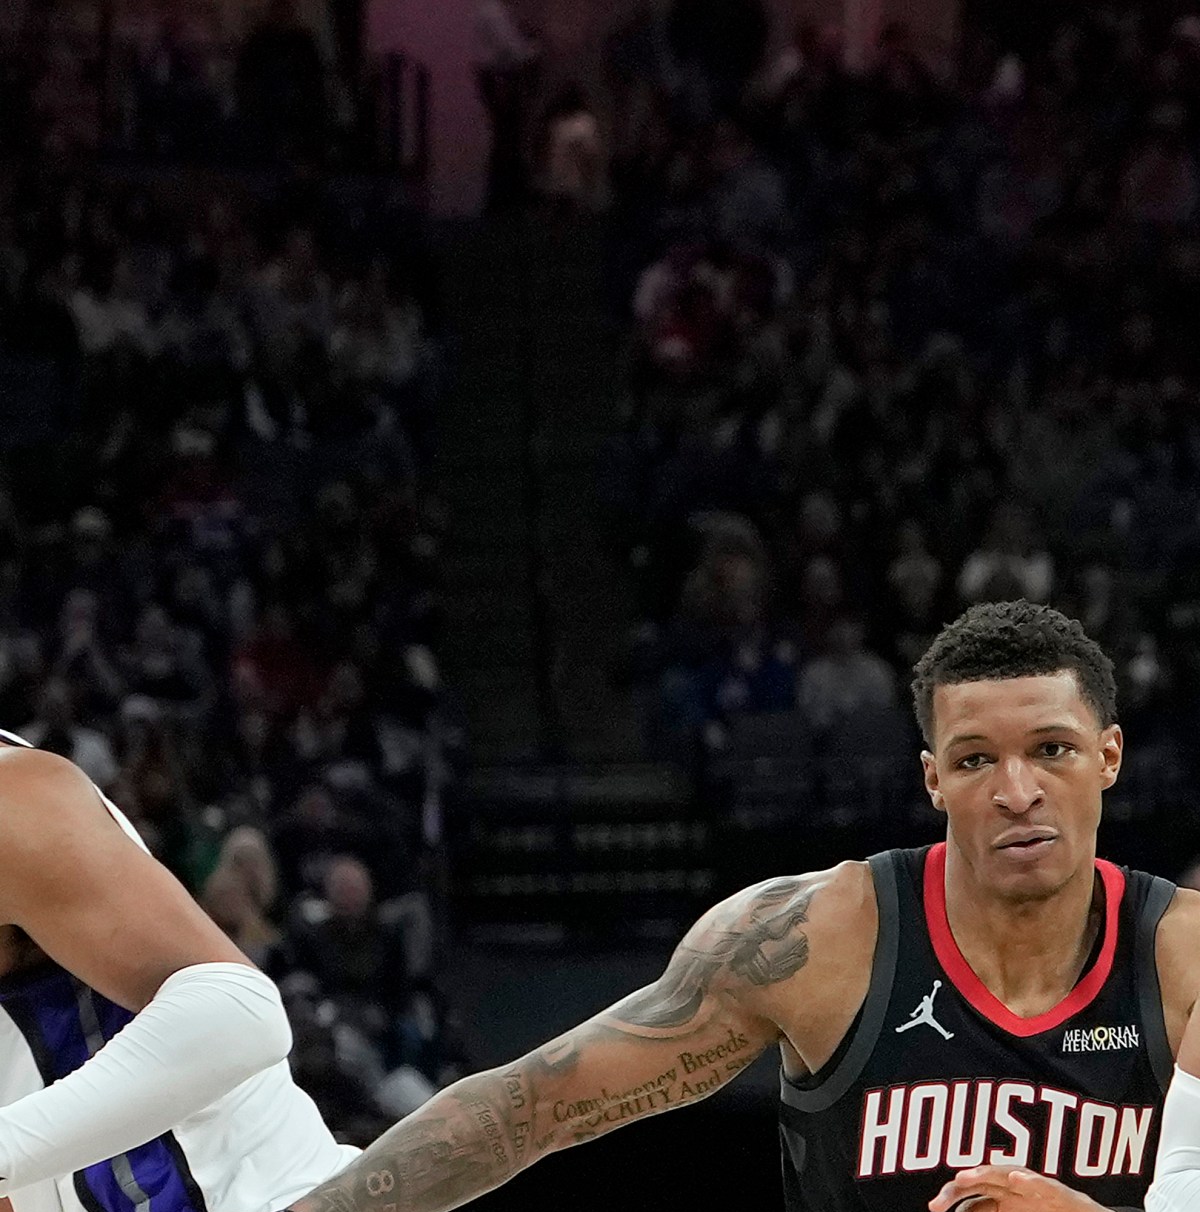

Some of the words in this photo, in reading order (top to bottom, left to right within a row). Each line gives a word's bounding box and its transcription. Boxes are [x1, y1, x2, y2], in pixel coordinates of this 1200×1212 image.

[1062, 1034, 1140, 1052] HERMANN
[1064, 1024, 1140, 1042] MEMORIAL
[677, 1028, 750, 1075] Breeds
[857, 1080, 1154, 1178] HOUSTON
